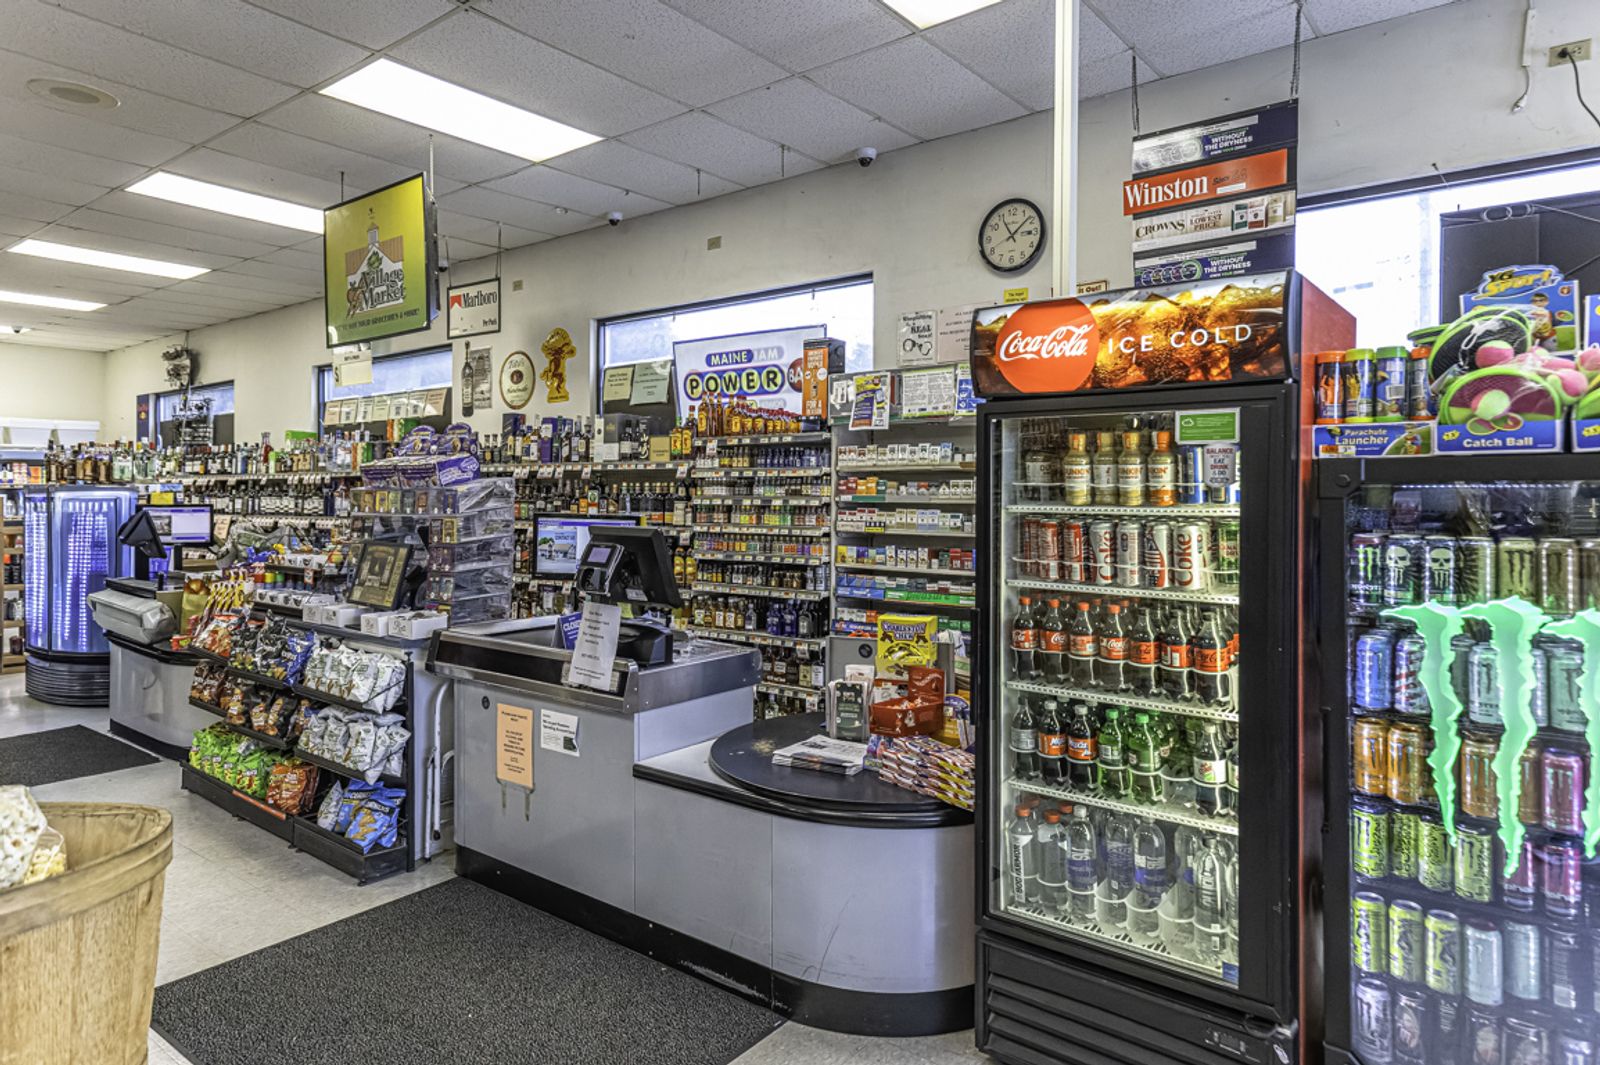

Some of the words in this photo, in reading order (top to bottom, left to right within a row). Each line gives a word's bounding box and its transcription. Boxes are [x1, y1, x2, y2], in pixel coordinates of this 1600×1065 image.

[1125, 176, 1208, 209] Winston
[1007, 207, 1018, 217] 12
[1021, 209, 1026, 218] 1
[1189, 214, 1223, 225] LOWEST
[989, 222, 1000, 232] 10
[1032, 227, 1038, 236] 3
[1136, 219, 1185, 239] CROWNS
[1194, 222, 1217, 232] PRICE
[985, 235, 992, 244] 9
[1028, 241, 1034, 249] 4
[998, 253, 1004, 262] 7
[1008, 255, 1015, 264] 6
[1020, 250, 1026, 259] 5
[1210, 256, 1244, 266] WITHOUT
[1218, 261, 1251, 272] DRYNESS
[360, 267, 404, 290] Village
[359, 283, 406, 311] Market
[463, 291, 497, 308] Marlboro
[1000, 323, 1095, 362] Coca-Cola
[1107, 335, 1154, 355] ICE
[1170, 324, 1252, 349] COLD
[711, 351, 748, 366] MAINE
[690, 370, 779, 396] POWER
[1344, 429, 1387, 437] Parachute
[1335, 436, 1389, 446] Launcher
[1463, 438, 1503, 448] Catch
[1506, 437, 1534, 446] Ball
[1175, 533, 1193, 587] Coke
